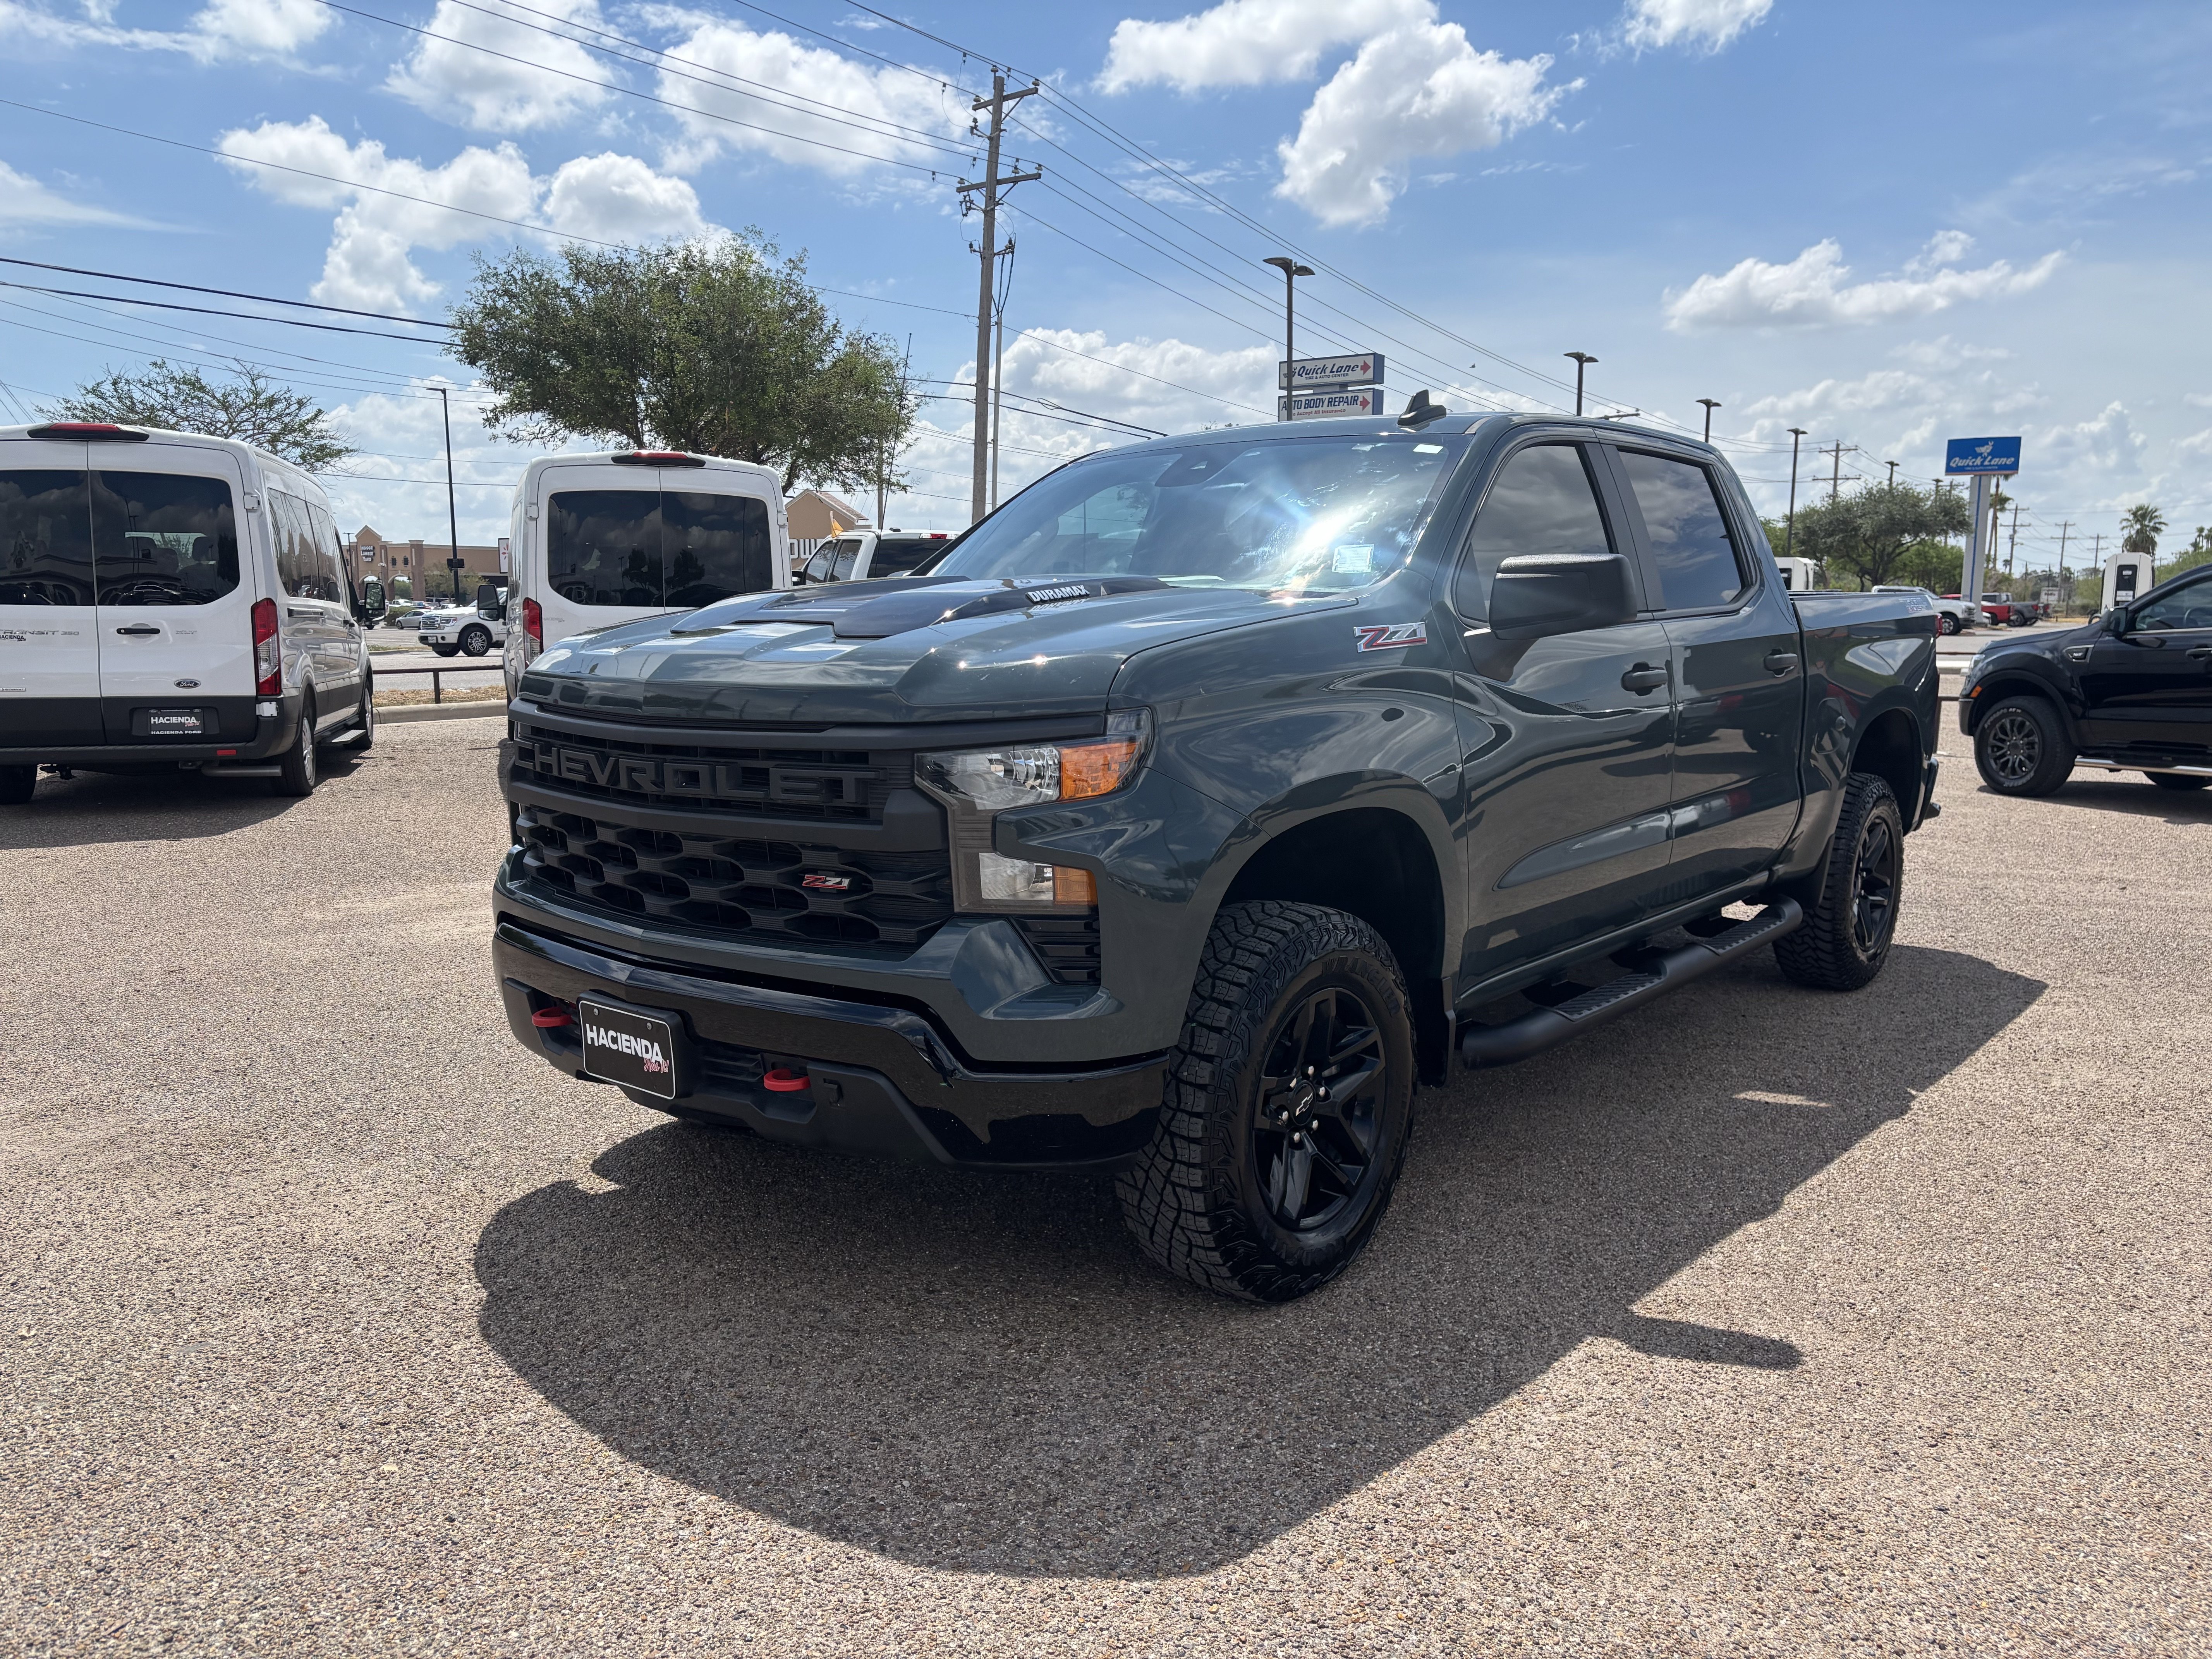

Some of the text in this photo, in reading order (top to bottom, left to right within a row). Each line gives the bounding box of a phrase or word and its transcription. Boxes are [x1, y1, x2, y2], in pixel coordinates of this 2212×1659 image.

[1298, 363, 1359, 377] Quick Lane
[1281, 395, 1359, 411] ATO BODY REPAIR
[1950, 455, 2014, 468] Quick Lane
[1027, 585, 1090, 602] DURAMAX
[1353, 622, 1427, 653] Z71
[514, 740, 886, 804] CHEVROLET
[802, 874, 852, 890] Z71
[1322, 955, 1401, 1018] WRANGLER
[586, 1024, 663, 1064] HACIENDA
[644, 1058, 660, 1072] Has
